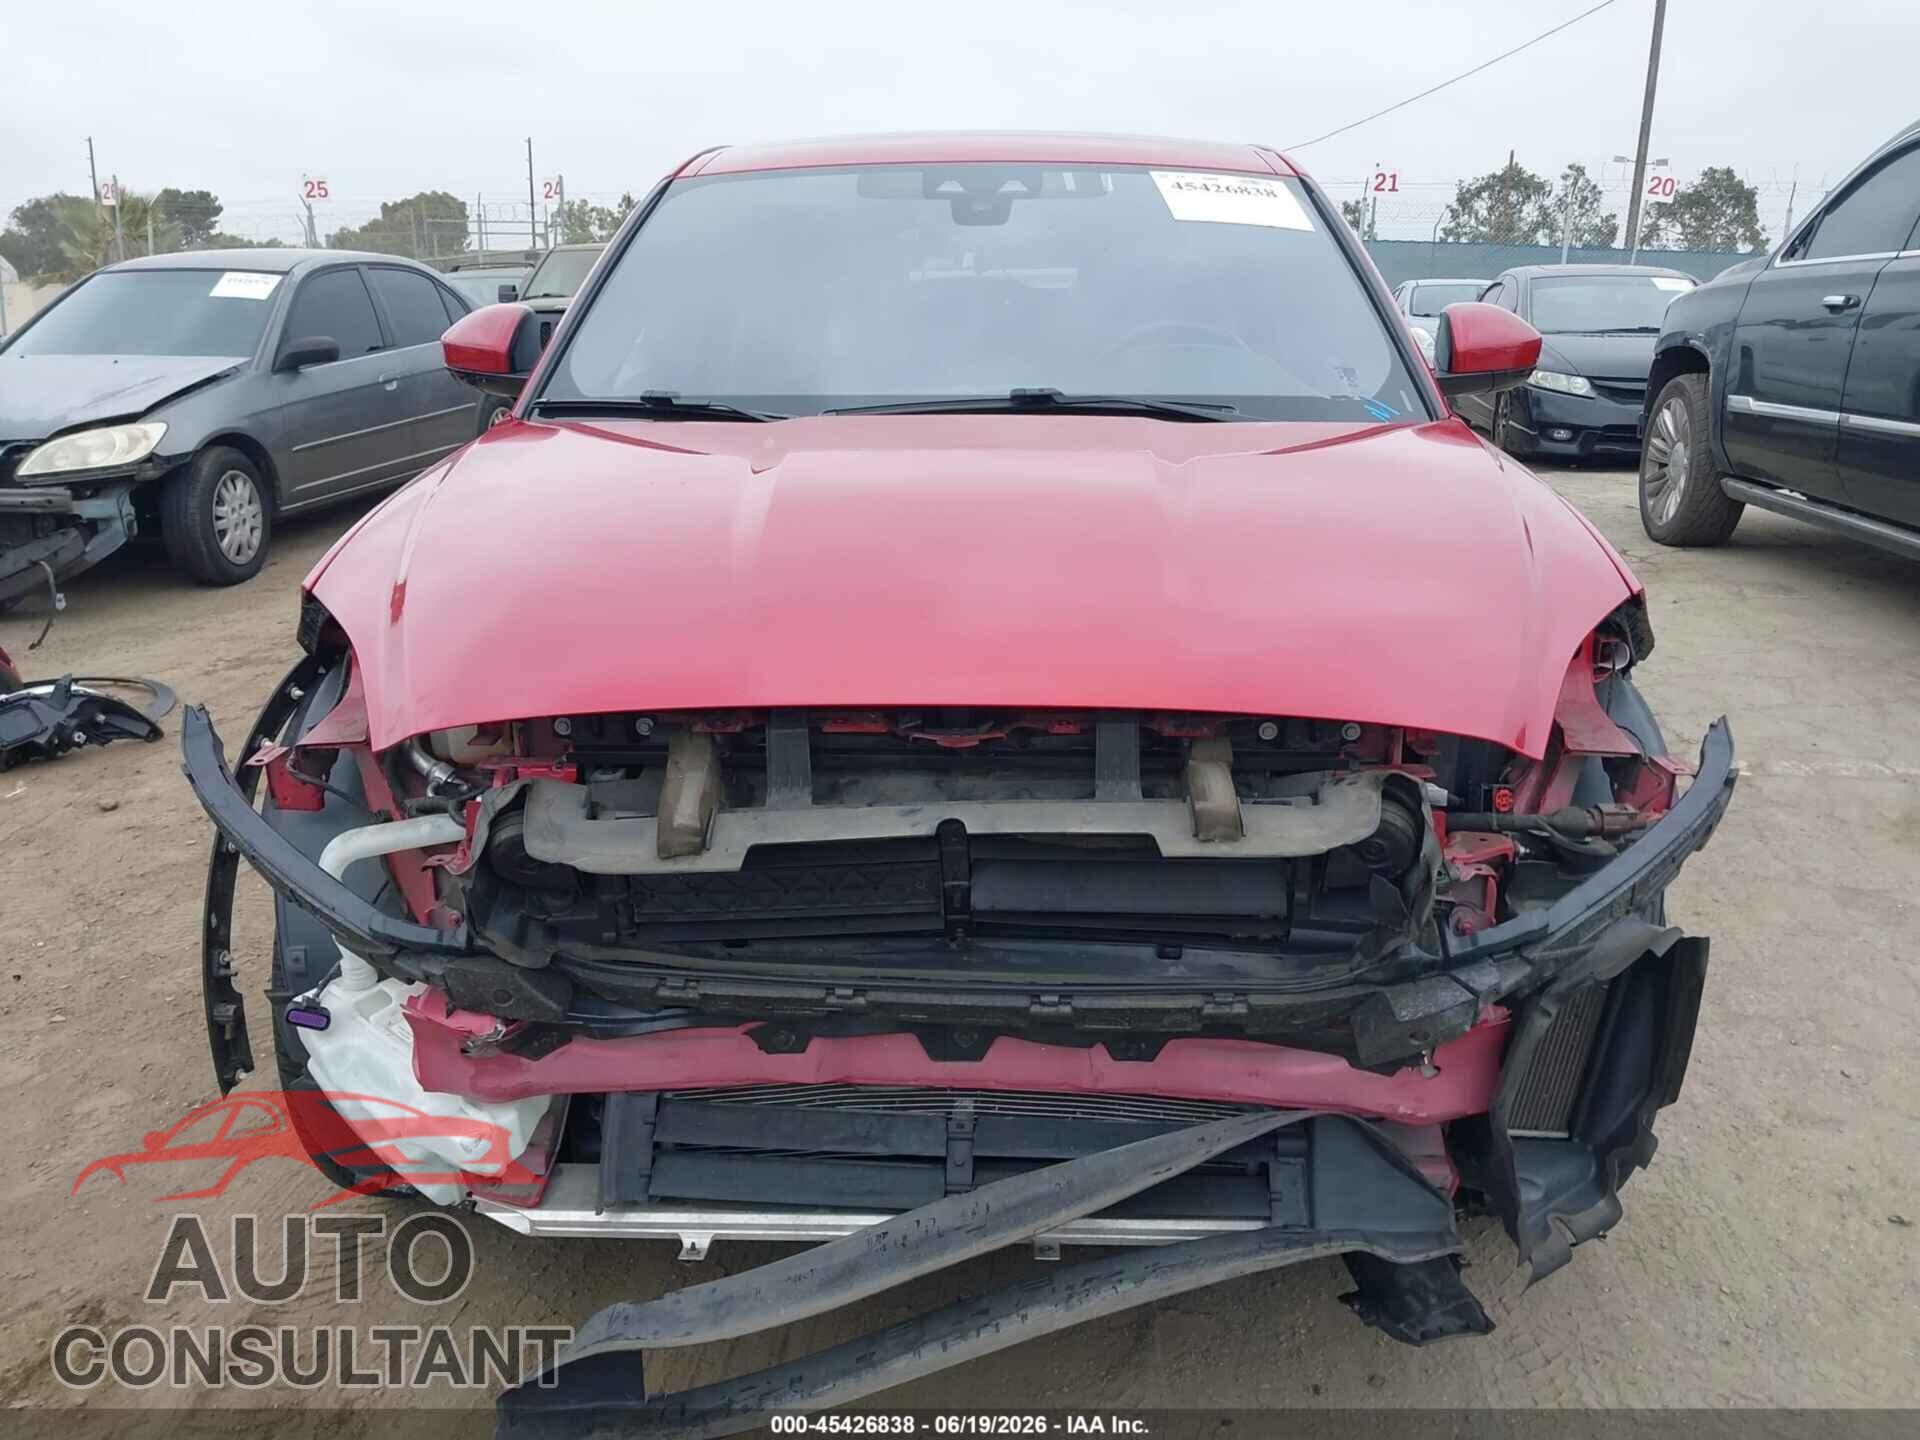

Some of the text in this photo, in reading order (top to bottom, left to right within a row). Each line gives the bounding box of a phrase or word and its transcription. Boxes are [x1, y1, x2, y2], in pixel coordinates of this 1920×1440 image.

[304, 180, 328, 198] 25
[1170, 181, 1278, 198] 45426838
[1374, 172, 1399, 192] 21
[1648, 176, 1675, 196] 20
